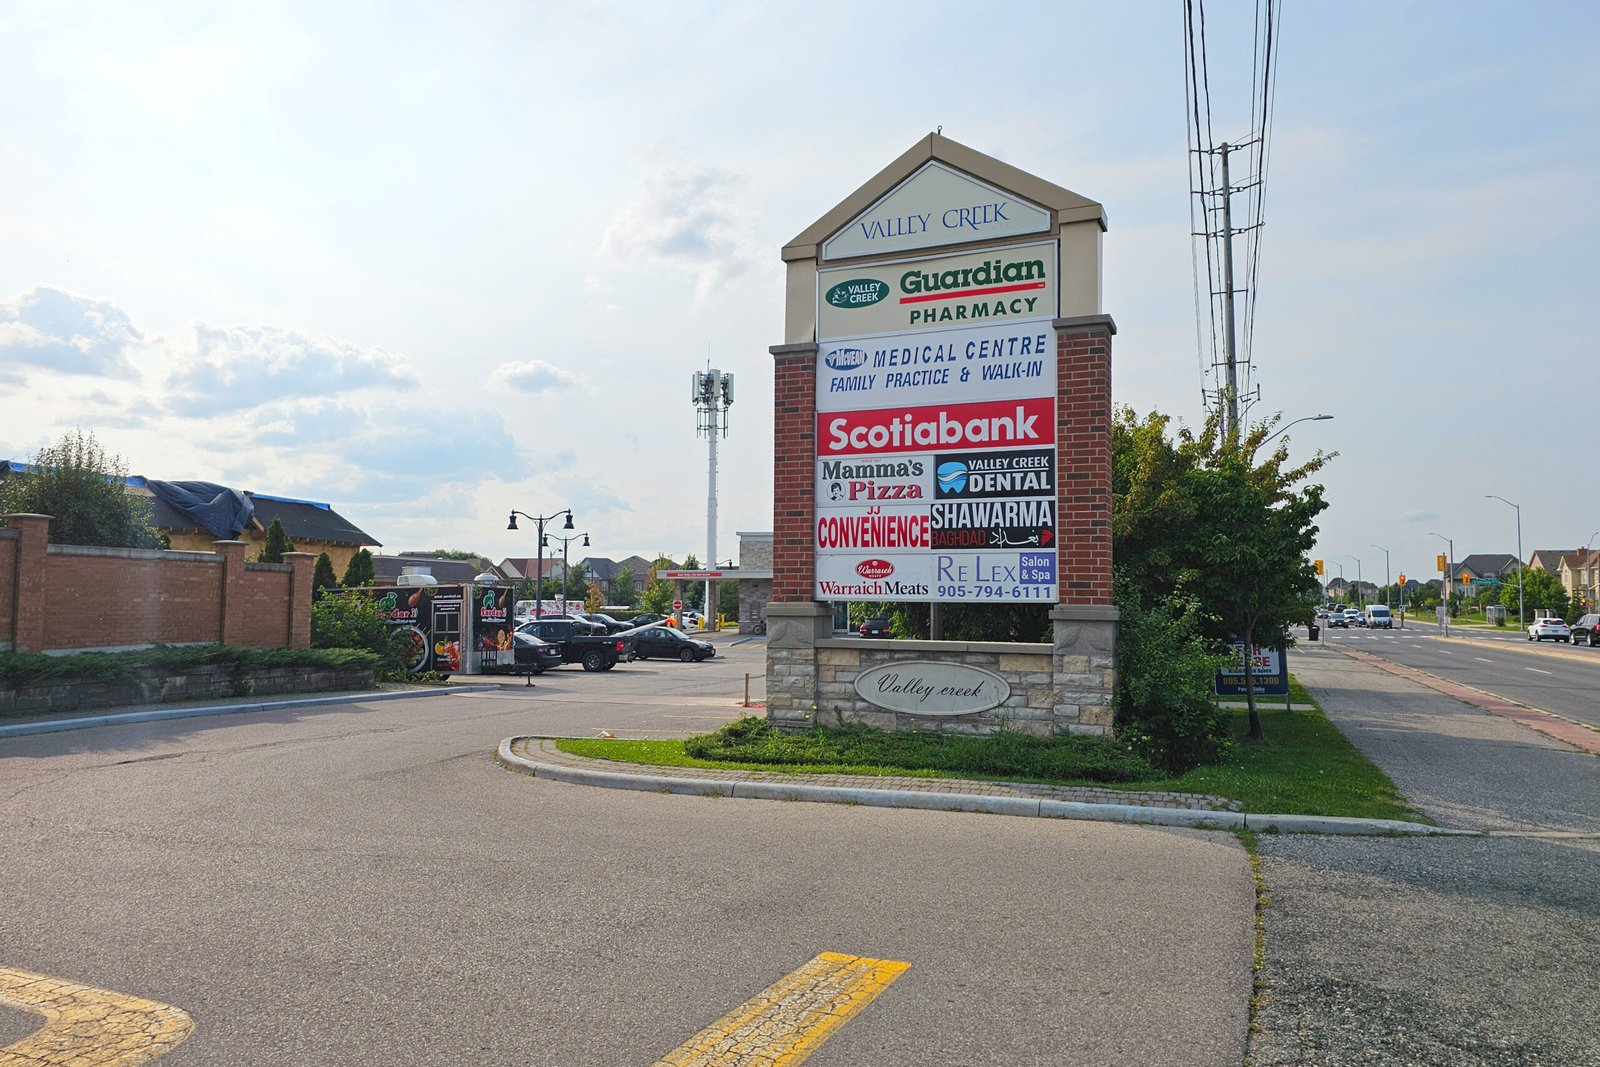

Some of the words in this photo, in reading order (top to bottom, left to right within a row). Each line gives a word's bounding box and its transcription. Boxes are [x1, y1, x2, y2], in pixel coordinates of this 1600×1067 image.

[860, 212, 932, 240] VALLEY
[942, 201, 1010, 231] CREEK
[899, 259, 1046, 294] Guardian
[848, 282, 881, 294] VALLEY
[849, 292, 879, 303] CREEK
[909, 296, 1039, 325] PHARMACY
[873, 343, 957, 368] MEDICAL
[965, 334, 1047, 359] CENTRE
[829, 374, 877, 393] FAMILY
[885, 368, 950, 389] PRACTICE
[959, 367, 971, 383] &
[981, 360, 1043, 381] WALK-IN
[828, 405, 1040, 451] Scotiabank
[822, 459, 924, 480] Mamma's
[968, 458, 1009, 471] VALLEY
[1012, 456, 1049, 469] CREEK
[848, 480, 924, 500] Pizza
[969, 472, 1051, 493] DENTAL
[866, 505, 881, 515] JJ
[931, 501, 1053, 529] SHAWARMA
[818, 515, 930, 549] CONVENIENCE
[931, 529, 986, 547] BAGHDAD
[1021, 556, 1050, 567] Salon
[1021, 569, 1029, 580] &
[1031, 569, 1051, 582] Spa
[818, 580, 883, 595] Warraich
[884, 580, 929, 595] Meats
[937, 585, 1051, 599] 905-794-6111
[877, 673, 935, 702] Valley
[937, 680, 986, 697] creek
